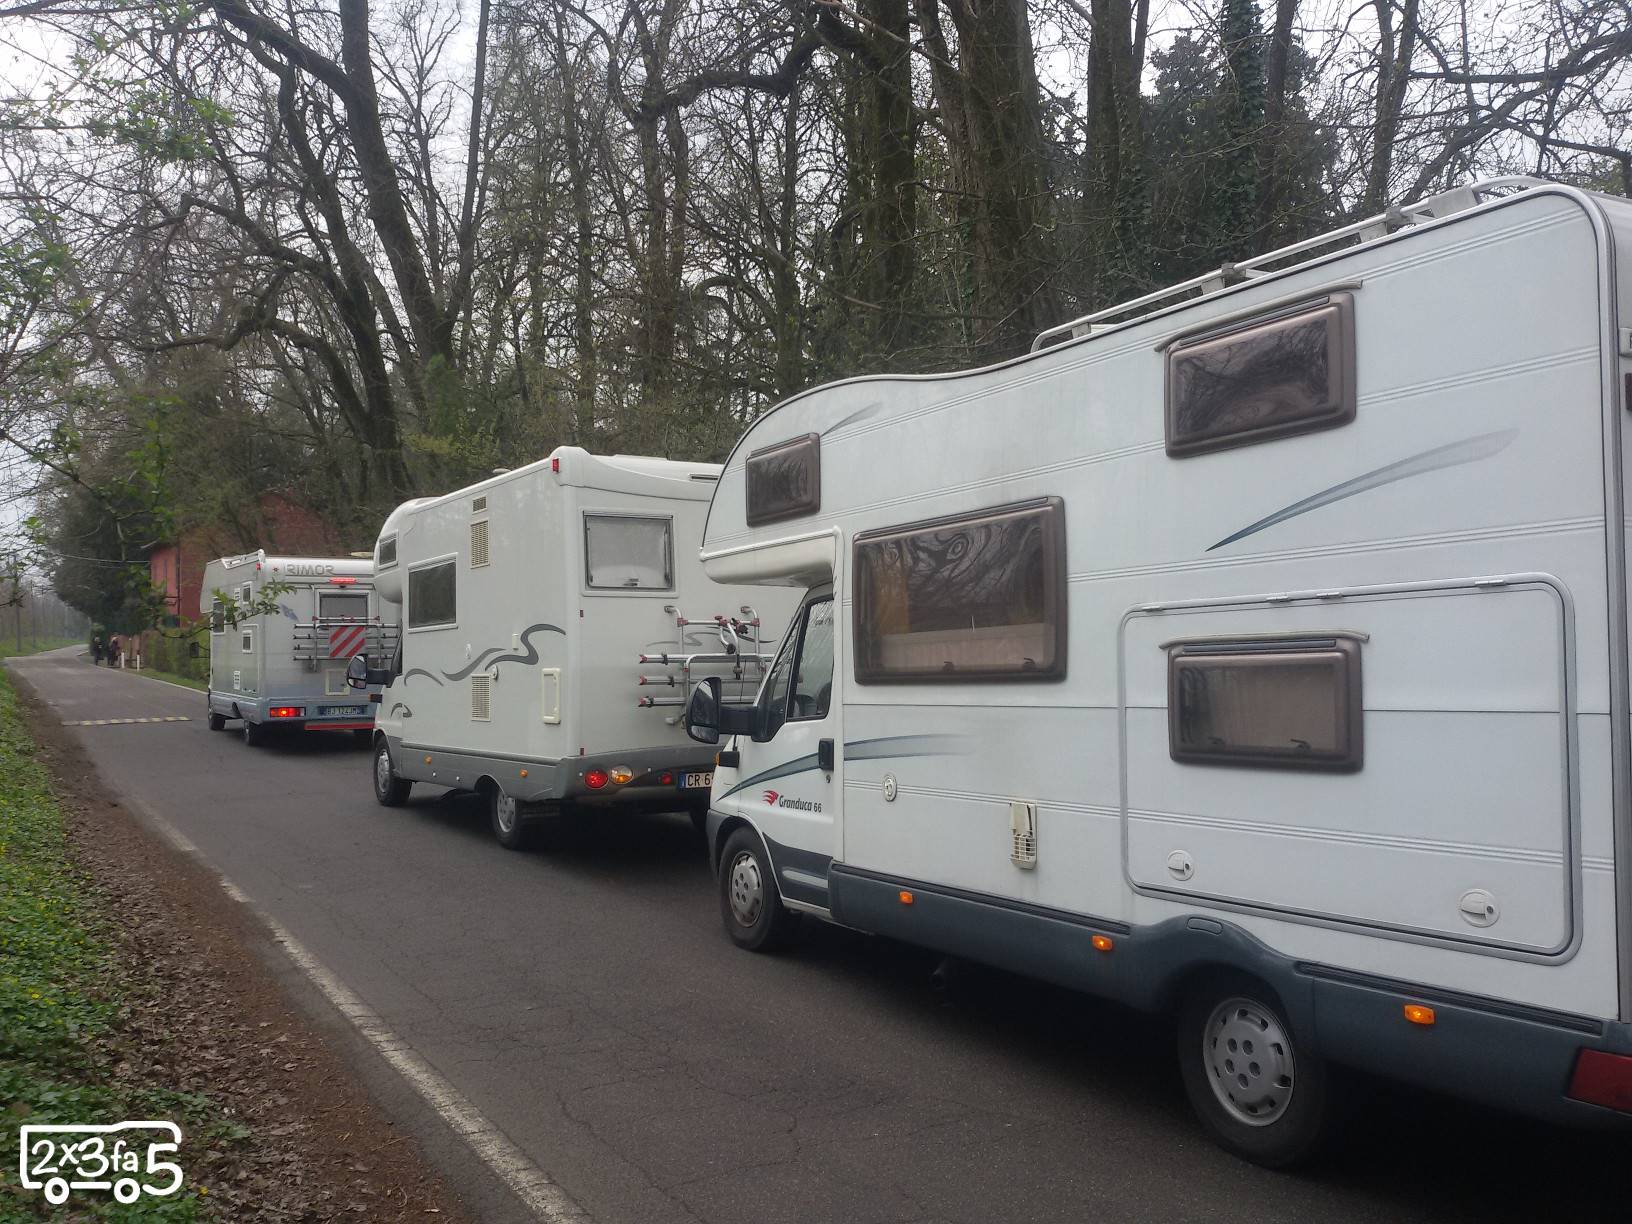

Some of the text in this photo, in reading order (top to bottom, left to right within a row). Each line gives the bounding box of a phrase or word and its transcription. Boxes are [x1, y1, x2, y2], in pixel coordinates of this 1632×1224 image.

[286, 564, 335, 575] RIMOR
[687, 773, 714, 787] CR 6
[778, 795, 822, 813] Granduca 66
